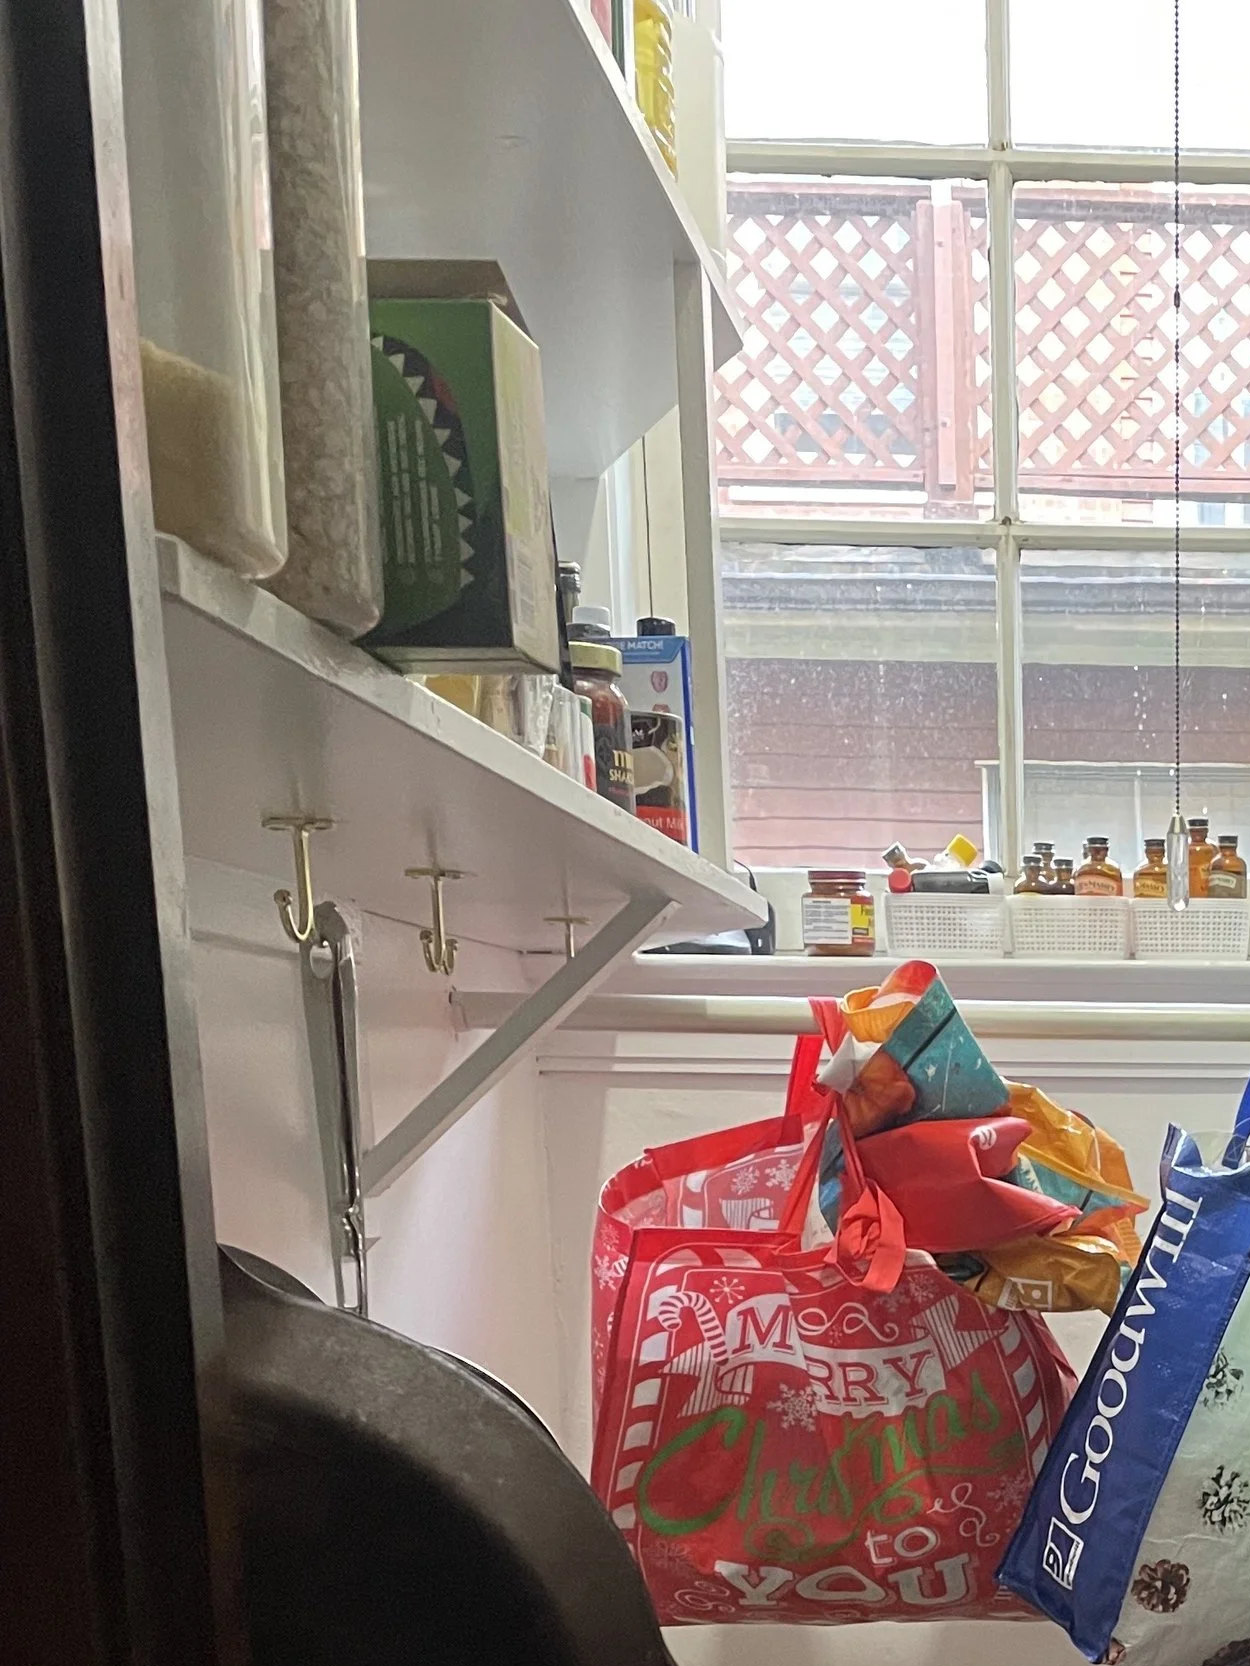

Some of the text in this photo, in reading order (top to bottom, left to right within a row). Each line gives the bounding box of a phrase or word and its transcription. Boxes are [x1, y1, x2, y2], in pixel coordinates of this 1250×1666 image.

[627, 640, 664, 650] MATCH!
[1058, 1186, 1204, 1526] Goodwill
[865, 1525, 941, 1566] to
[714, 1552, 972, 1607] YOU
